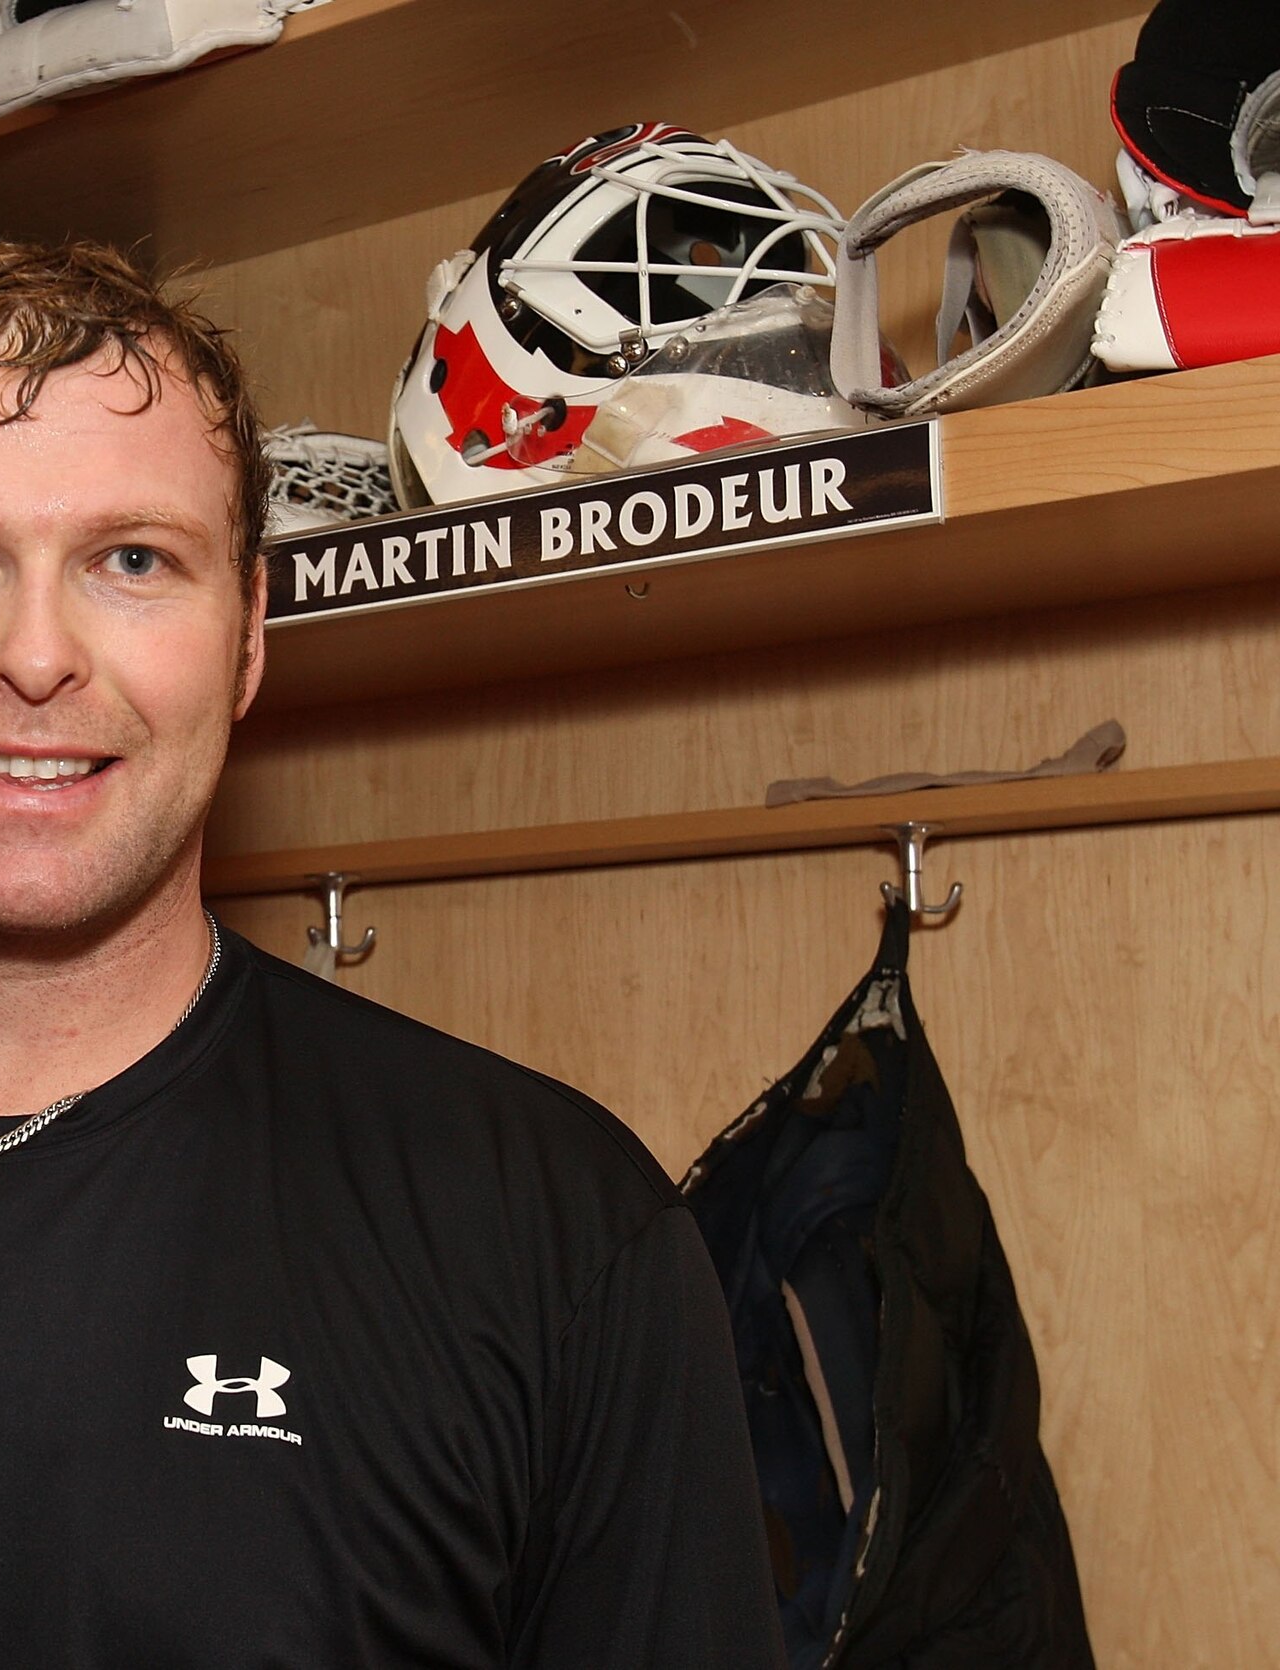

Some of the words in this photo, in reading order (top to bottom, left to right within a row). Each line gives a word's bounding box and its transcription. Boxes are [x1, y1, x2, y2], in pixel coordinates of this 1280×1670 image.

[293, 515, 512, 602] MARTIN
[540, 458, 853, 562] BRODEUR
[163, 1416, 223, 1437] UNDER
[226, 1424, 302, 1446] ARMOUR
